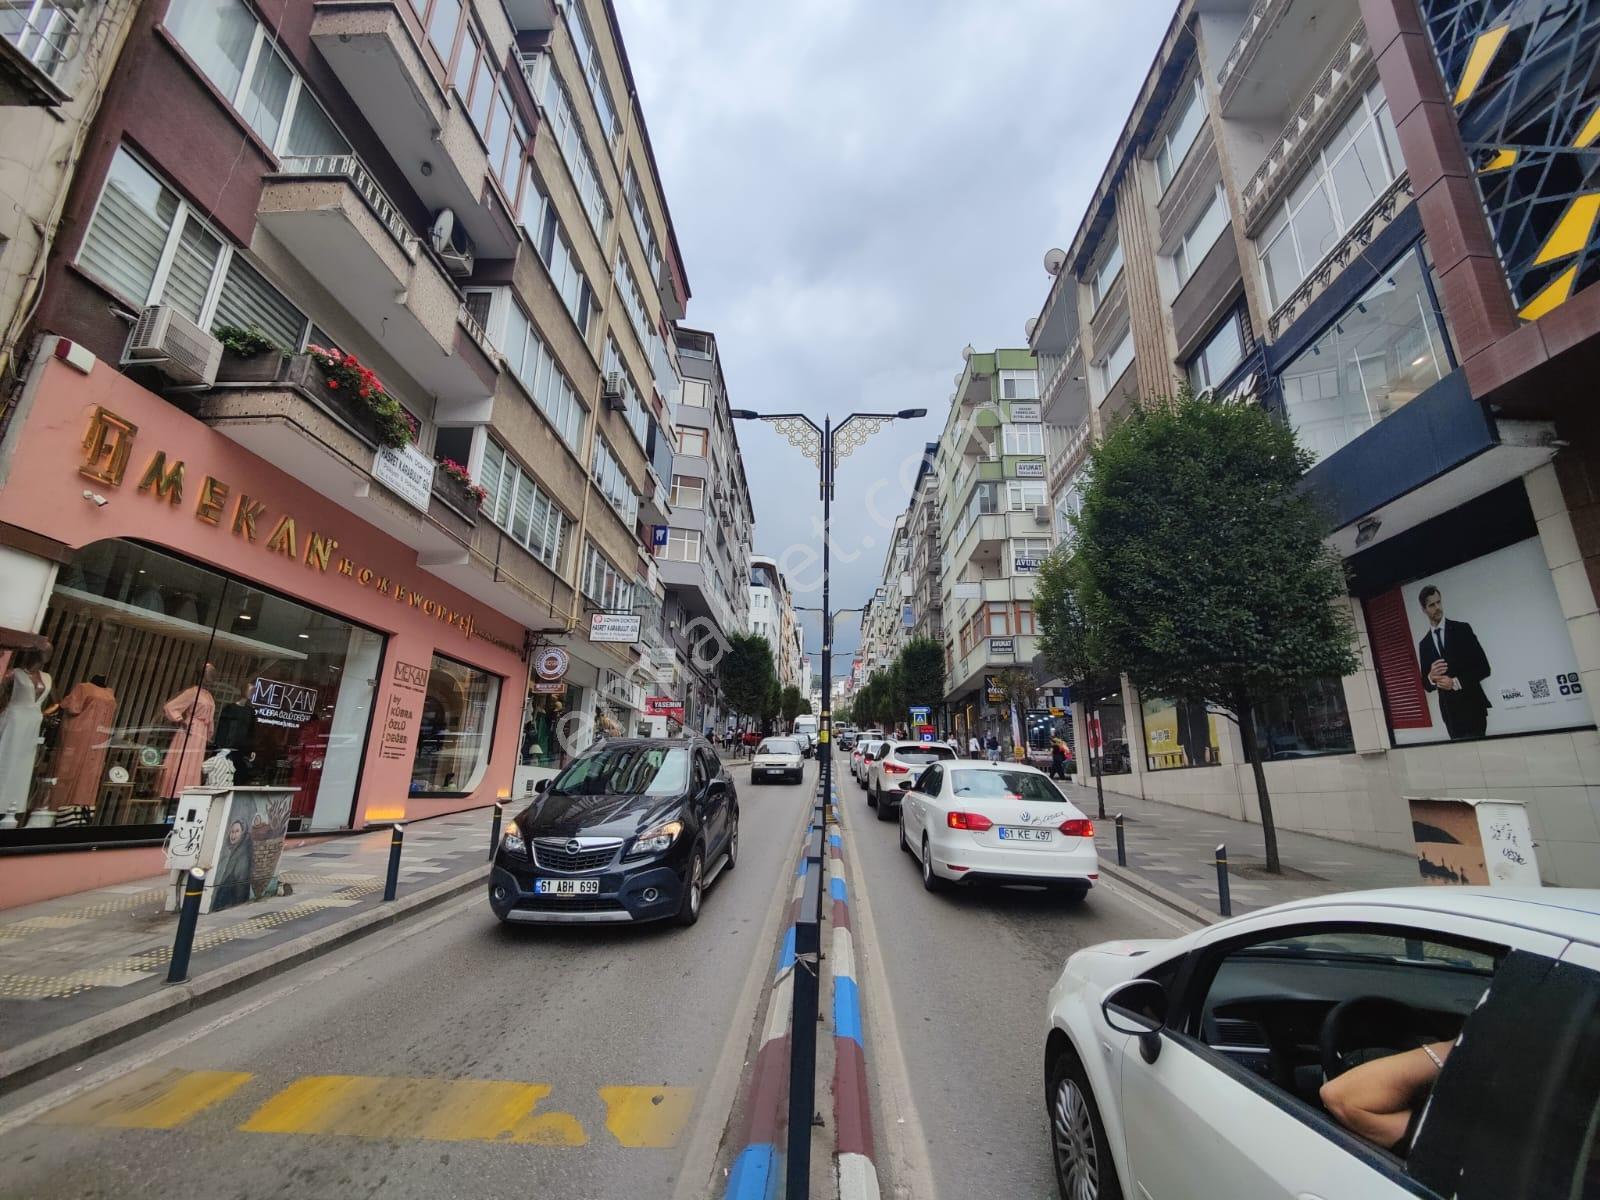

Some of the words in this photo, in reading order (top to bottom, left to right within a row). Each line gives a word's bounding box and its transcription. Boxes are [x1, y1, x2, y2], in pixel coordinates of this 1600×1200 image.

[137, 450, 333, 571] MEKAN
[395, 664, 426, 686] MEKAN
[255, 681, 316, 711] MEKAN
[1005, 829, 1014, 838] 61
[1018, 830, 1030, 839] KE
[1035, 831, 1050, 840] 497
[541, 881, 551, 892] 61
[557, 881, 574, 892] ABH
[580, 881, 598, 892] 699
